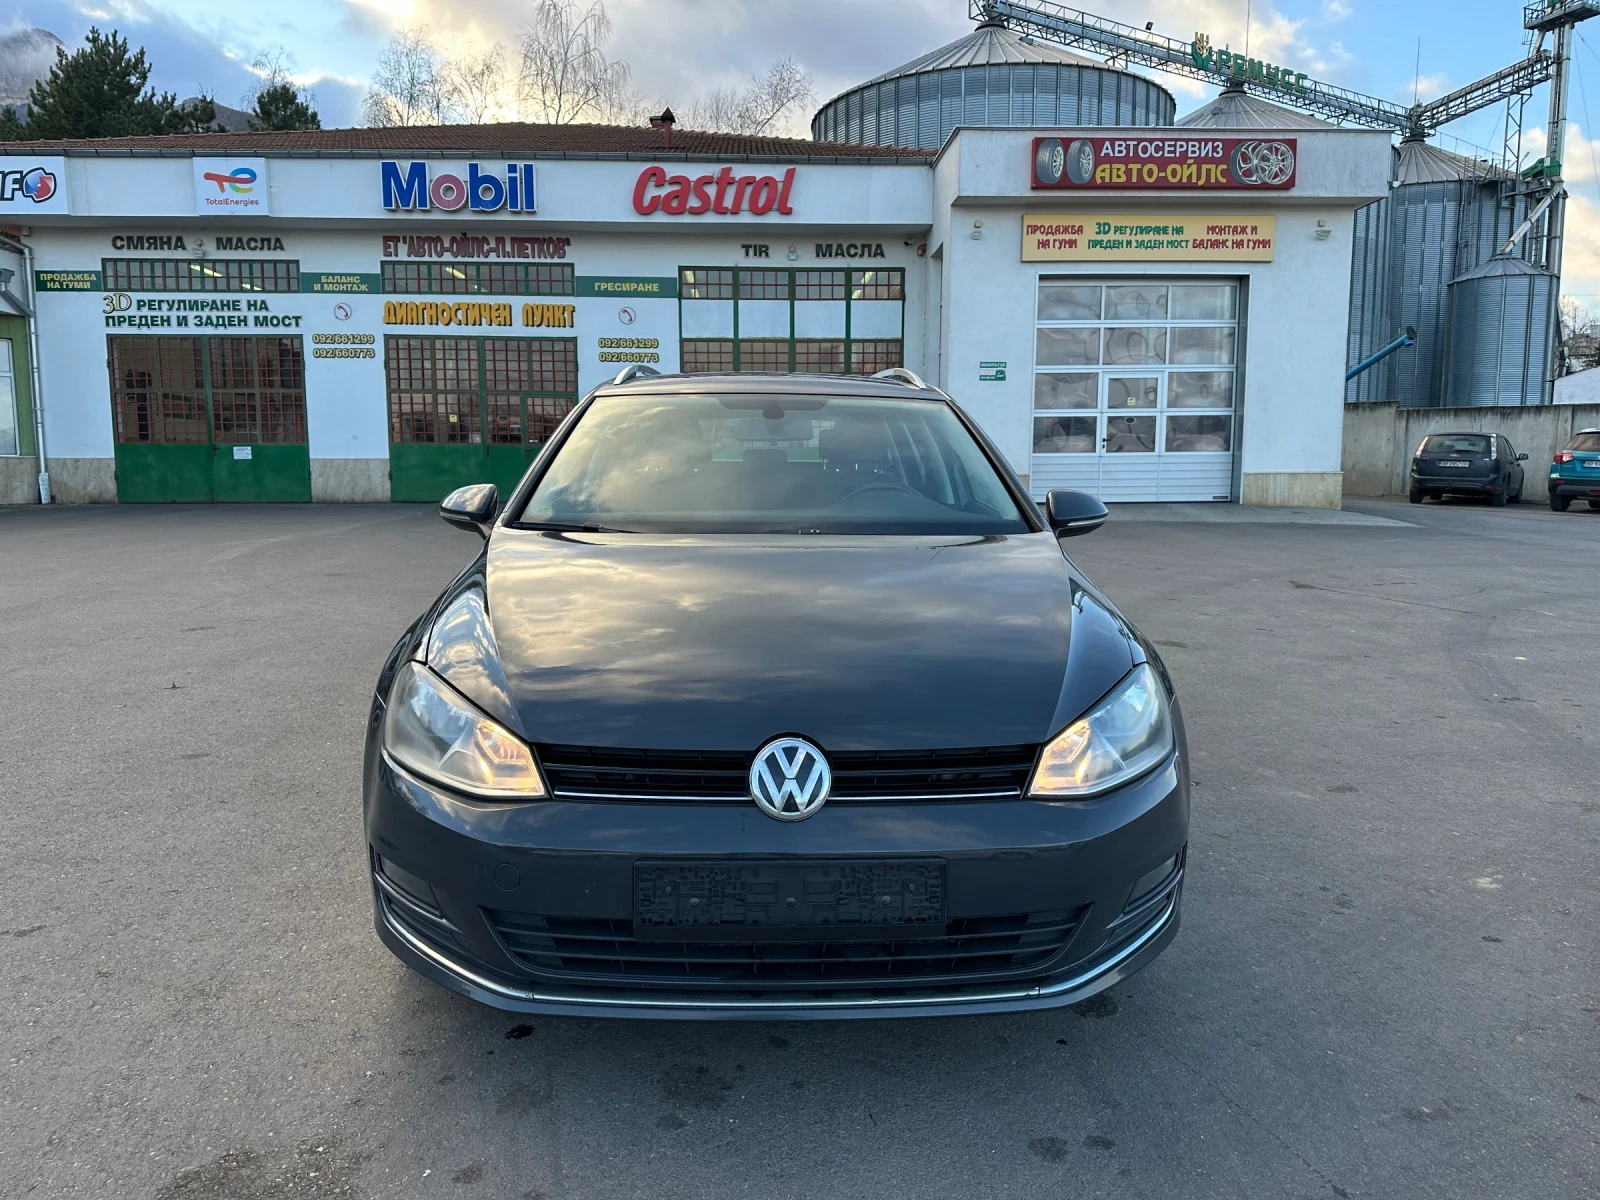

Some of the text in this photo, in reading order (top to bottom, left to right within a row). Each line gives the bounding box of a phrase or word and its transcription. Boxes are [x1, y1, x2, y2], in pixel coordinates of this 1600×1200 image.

[1217, 48, 1308, 95] РЕМУСС
[1101, 140, 1223, 158] АВТОСЕРВИЗ
[1095, 159, 1228, 186] АВТО-ОЙЛС
[380, 161, 537, 212] Mobil
[632, 165, 796, 215] Castrol
[205, 198, 259, 206] TotalEnergies
[1026, 225, 1084, 236] ПРОДАЖБА
[1095, 222, 1184, 236] 3D РЕГУЛИРАНЕ НА
[1206, 225, 1258, 236] МОНТАЖ И
[111, 236, 285, 251] СМЯНА МАСЛА
[1037, 239, 1078, 250] НА ГУМИ
[1087, 239, 1190, 250] ПРЕДЕН И ЗАДЕН МОСТ
[1192, 239, 1271, 250] БАЛАНС НА ГУМИ
[741, 244, 885, 258] TIR МАСЛА
[40, 273, 97, 282] ПРОДАЖБА
[321, 275, 361, 283] БАЛАНС
[46, 281, 91, 289] НА ГУМИ
[313, 283, 369, 292] И МОНТАЖ
[594, 282, 660, 292] ГРЕСИРАНЕ
[102, 292, 269, 314] 3D РЕГУЛИРАНЕ НА
[383, 300, 575, 328] ДИАГНОСТИЧЕН ПУНКТ
[105, 315, 302, 329] ПРЕДЕН И ЗАДЕН МОСТ
[312, 333, 375, 345] 092/661299
[597, 338, 660, 349] 092/661299
[312, 347, 376, 359] 092/660773
[598, 351, 660, 364] 092/660773
